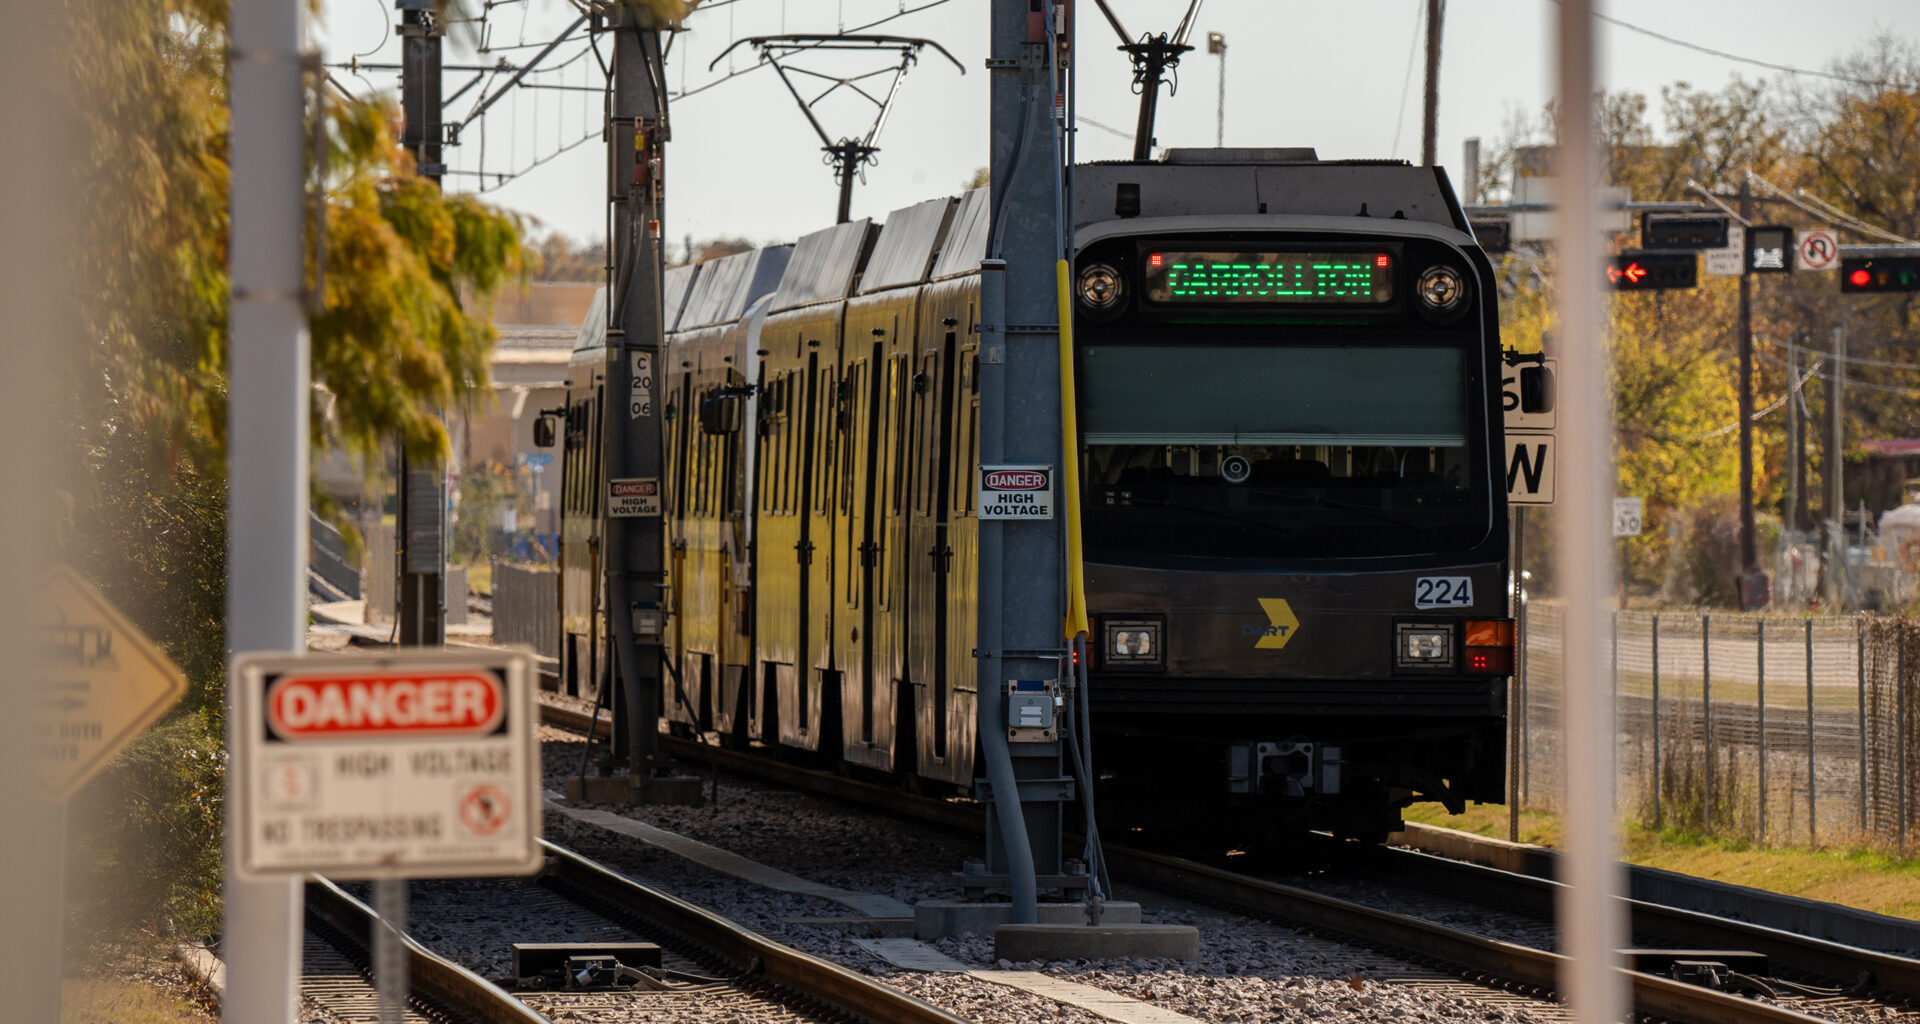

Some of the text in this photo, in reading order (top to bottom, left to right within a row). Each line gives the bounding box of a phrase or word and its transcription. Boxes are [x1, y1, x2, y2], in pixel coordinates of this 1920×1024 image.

[1169, 264, 1371, 295] CARROLLTON
[637, 358, 647, 370] C
[632, 376, 651, 389] 20
[632, 402, 650, 415] 06
[990, 475, 1042, 486] DANGER
[615, 482, 653, 494] DANGER
[621, 497, 648, 506] HIGH
[998, 494, 1034, 503] HIGH
[612, 506, 658, 515] VOLTAGE
[984, 505, 1048, 515] VOLTAGE
[1416, 579, 1470, 605] 224
[1241, 624, 1290, 638] DART
[280, 679, 488, 730] DANGER
[335, 749, 513, 779] HIGH VOLTAGE
[264, 813, 443, 844] NO TRESPASSING
